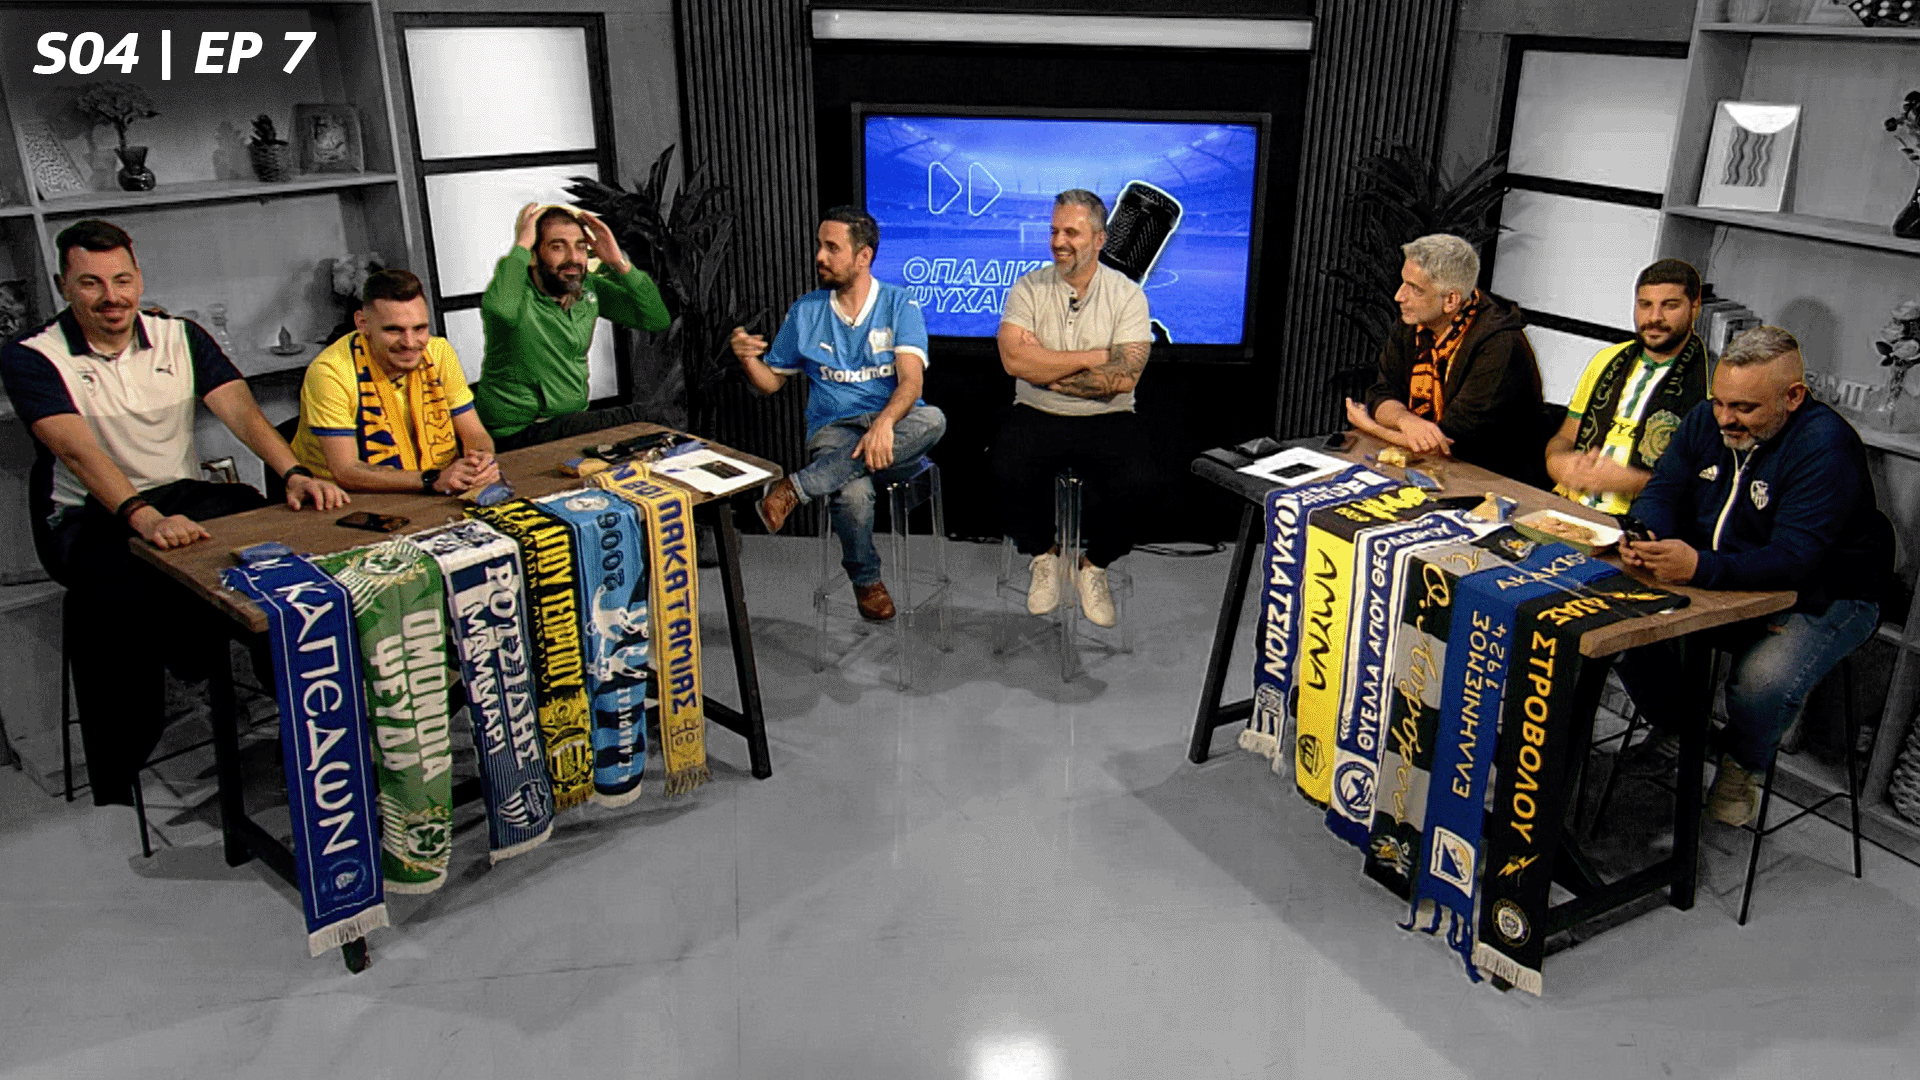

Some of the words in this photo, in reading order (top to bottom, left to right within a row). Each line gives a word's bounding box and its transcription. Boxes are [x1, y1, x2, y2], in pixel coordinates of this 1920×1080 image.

[903, 257, 1054, 286] ΟΠΑΔΙΚ
[905, 286, 1009, 313] ΨΥΧΑ
[596, 513, 624, 591] 2006
[1368, 590, 1389, 657] ΑΓΙΟΥ
[1485, 623, 1508, 690] 1924
[461, 603, 507, 755] ΜΑΜΜΑΡΙ
[484, 561, 540, 771] ΡΟΤΣΙΔΗΣ
[1452, 610, 1490, 799] ΕΛΛΗΝΙΣΜΟΣ
[1357, 664, 1382, 751] ΘΥΕΛΛΑ
[1510, 630, 1557, 844] ΣΤΡΟΒΟΛΟΥ
